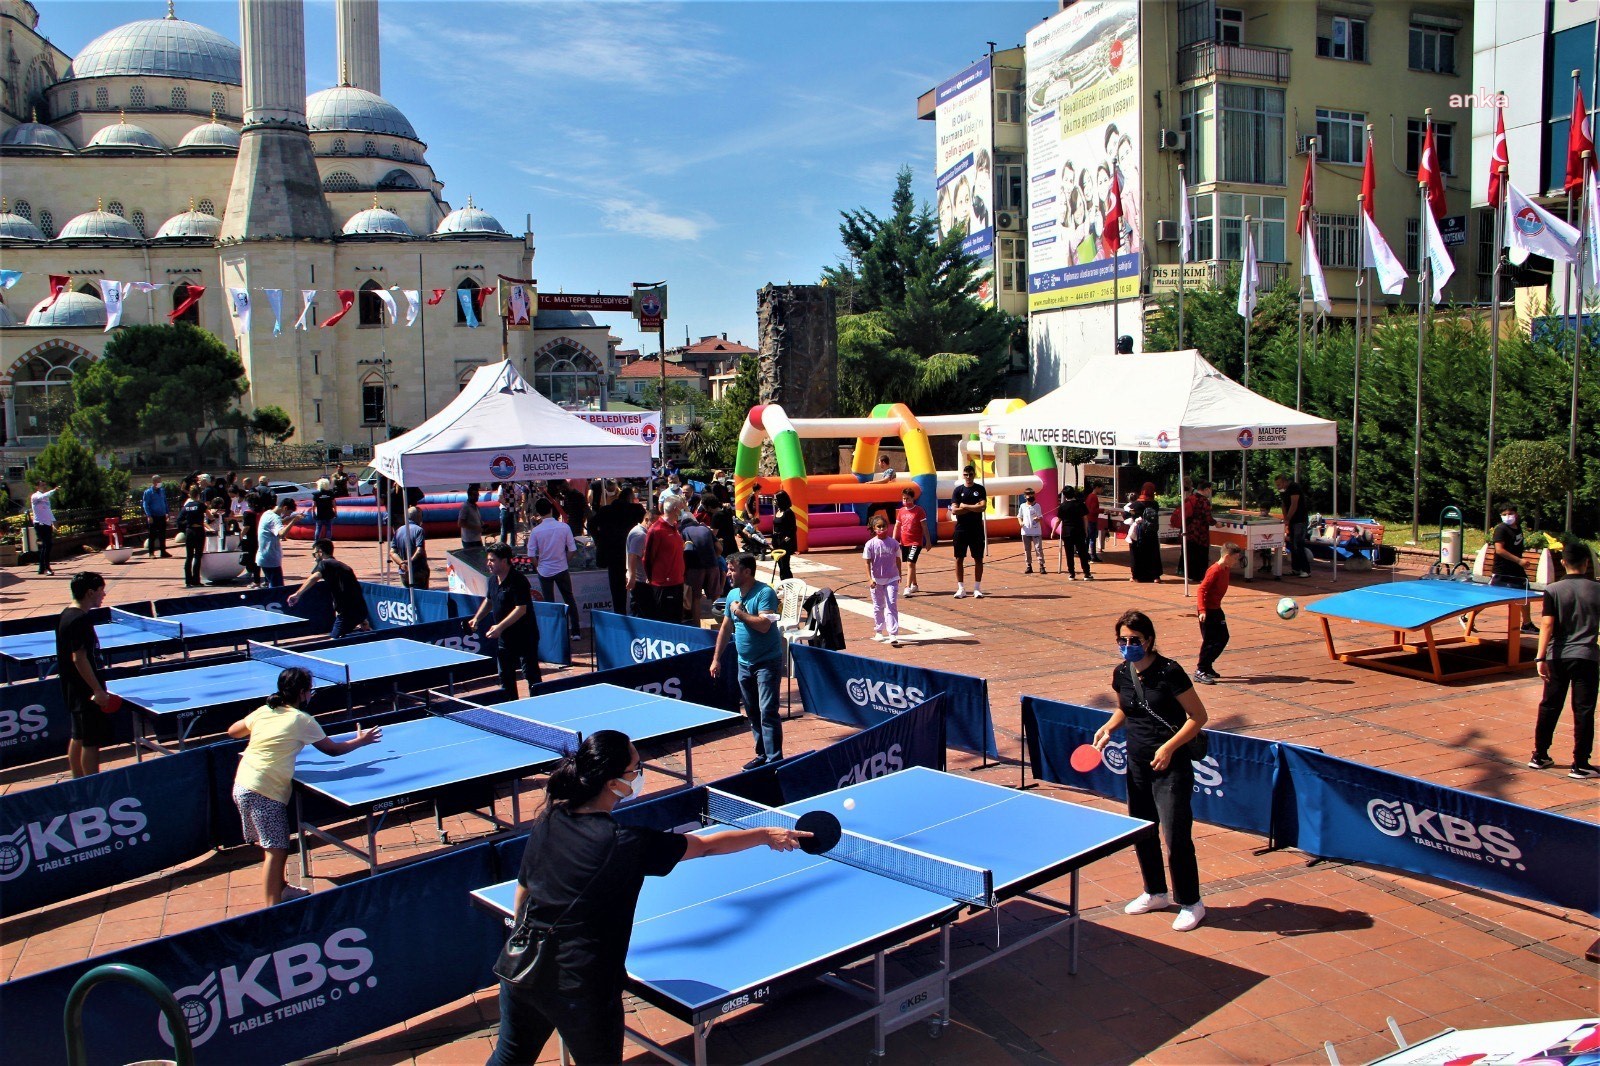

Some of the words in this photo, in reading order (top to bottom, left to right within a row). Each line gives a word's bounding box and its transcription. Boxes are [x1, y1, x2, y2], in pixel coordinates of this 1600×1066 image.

[1033, 33, 1050, 48] maltepe
[1063, 90, 1096, 116] Hayalinizdeki
[1098, 74, 1134, 101] üniversitede
[1063, 117, 1081, 133] okuma
[1112, 95, 1135, 117] yaşayın
[941, 128, 963, 146] Marmara
[944, 147, 957, 161] gelin
[1170, 266, 1206, 277] HKİMİ
[554, 296, 586, 304] MALTEPE
[590, 296, 629, 305] BELEDİYESİ
[1075, 292, 1083, 300] 444
[589, 414, 642, 424] BELEDİYESİ
[1020, 428, 1060, 442] MALTEPE
[1258, 427, 1287, 435] MALTEPE
[522, 453, 568, 463] MALTEPE
[387, 600, 418, 622] KBS
[434, 633, 481, 655] BS
[872, 703, 888, 713] TABLE
[0, 704, 49, 739] BS
[854, 743, 903, 785] KBS
[27, 797, 148, 861] KBS
[1403, 802, 1522, 860] KBS
[37, 856, 71, 873] TABLE
[71, 845, 112, 863] TENNIS
[1412, 835, 1443, 851] TABLE
[1443, 845, 1482, 861] TENNIS
[220, 927, 374, 1019] KBS
[729, 994, 750, 1009] KBS
[753, 986, 771, 999] 18-1
[907, 991, 928, 1007] KBS
[229, 1014, 274, 1035] TABLE
[275, 994, 326, 1020] TENNIS
